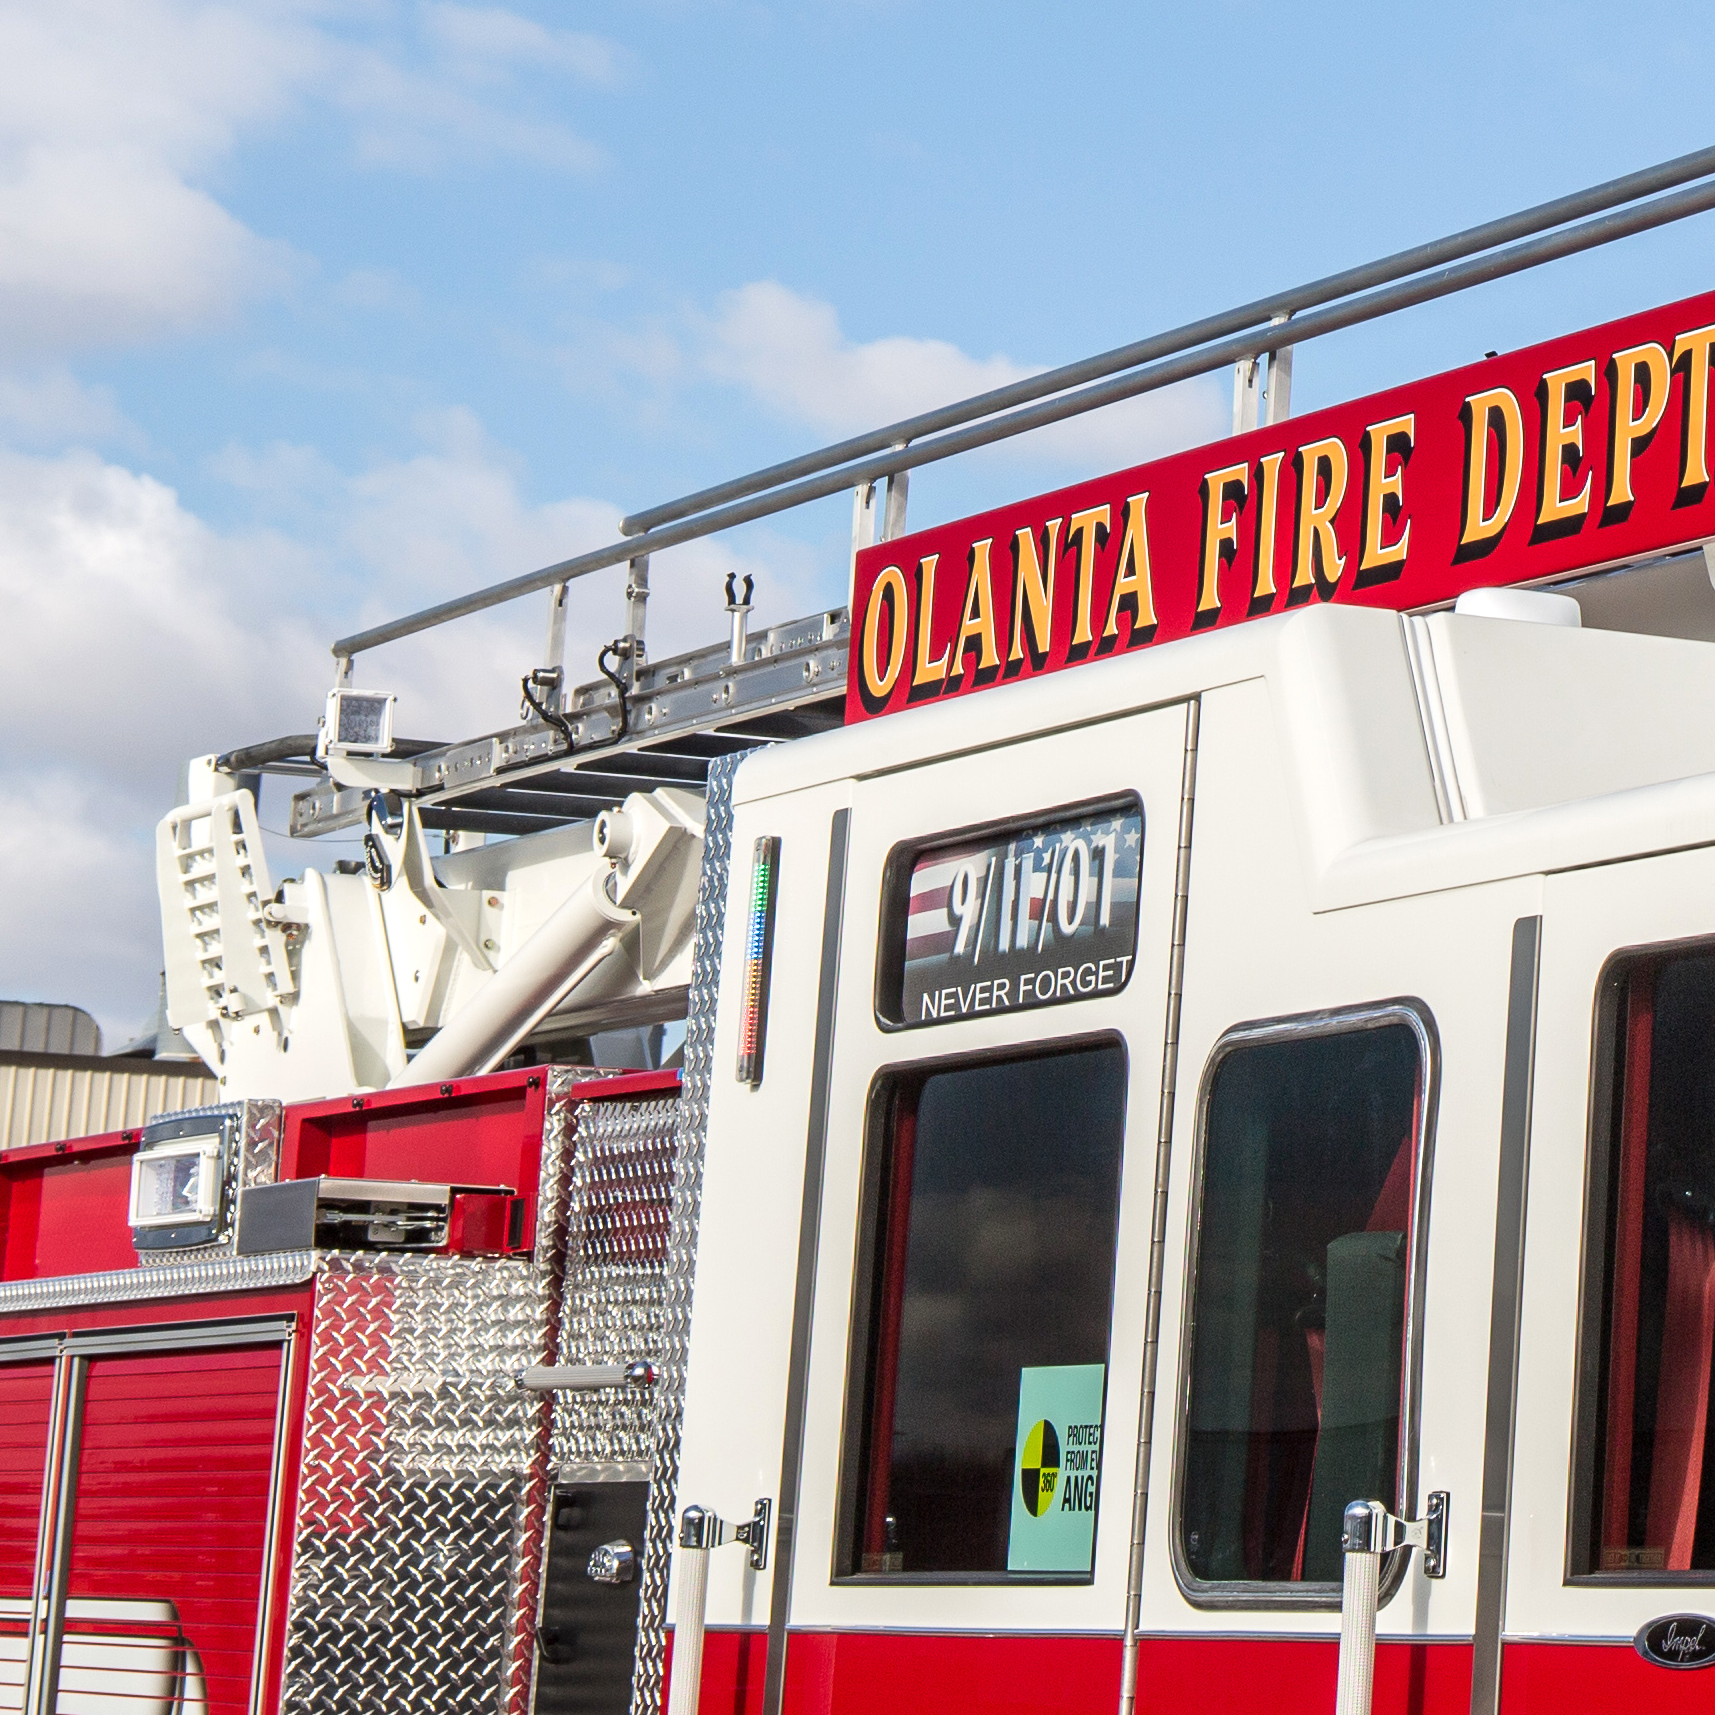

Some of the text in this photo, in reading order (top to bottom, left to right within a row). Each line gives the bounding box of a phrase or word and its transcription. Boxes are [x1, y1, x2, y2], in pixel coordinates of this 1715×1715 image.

[859, 491, 1158, 710] OLANTA
[1191, 413, 1416, 628] FIRE
[952, 832, 1116, 966] 9/11/01
[921, 955, 1133, 1020] NEVER FORGET
[1061, 1474, 1096, 1512] ANG
[1065, 1450, 1088, 1471] FROM
